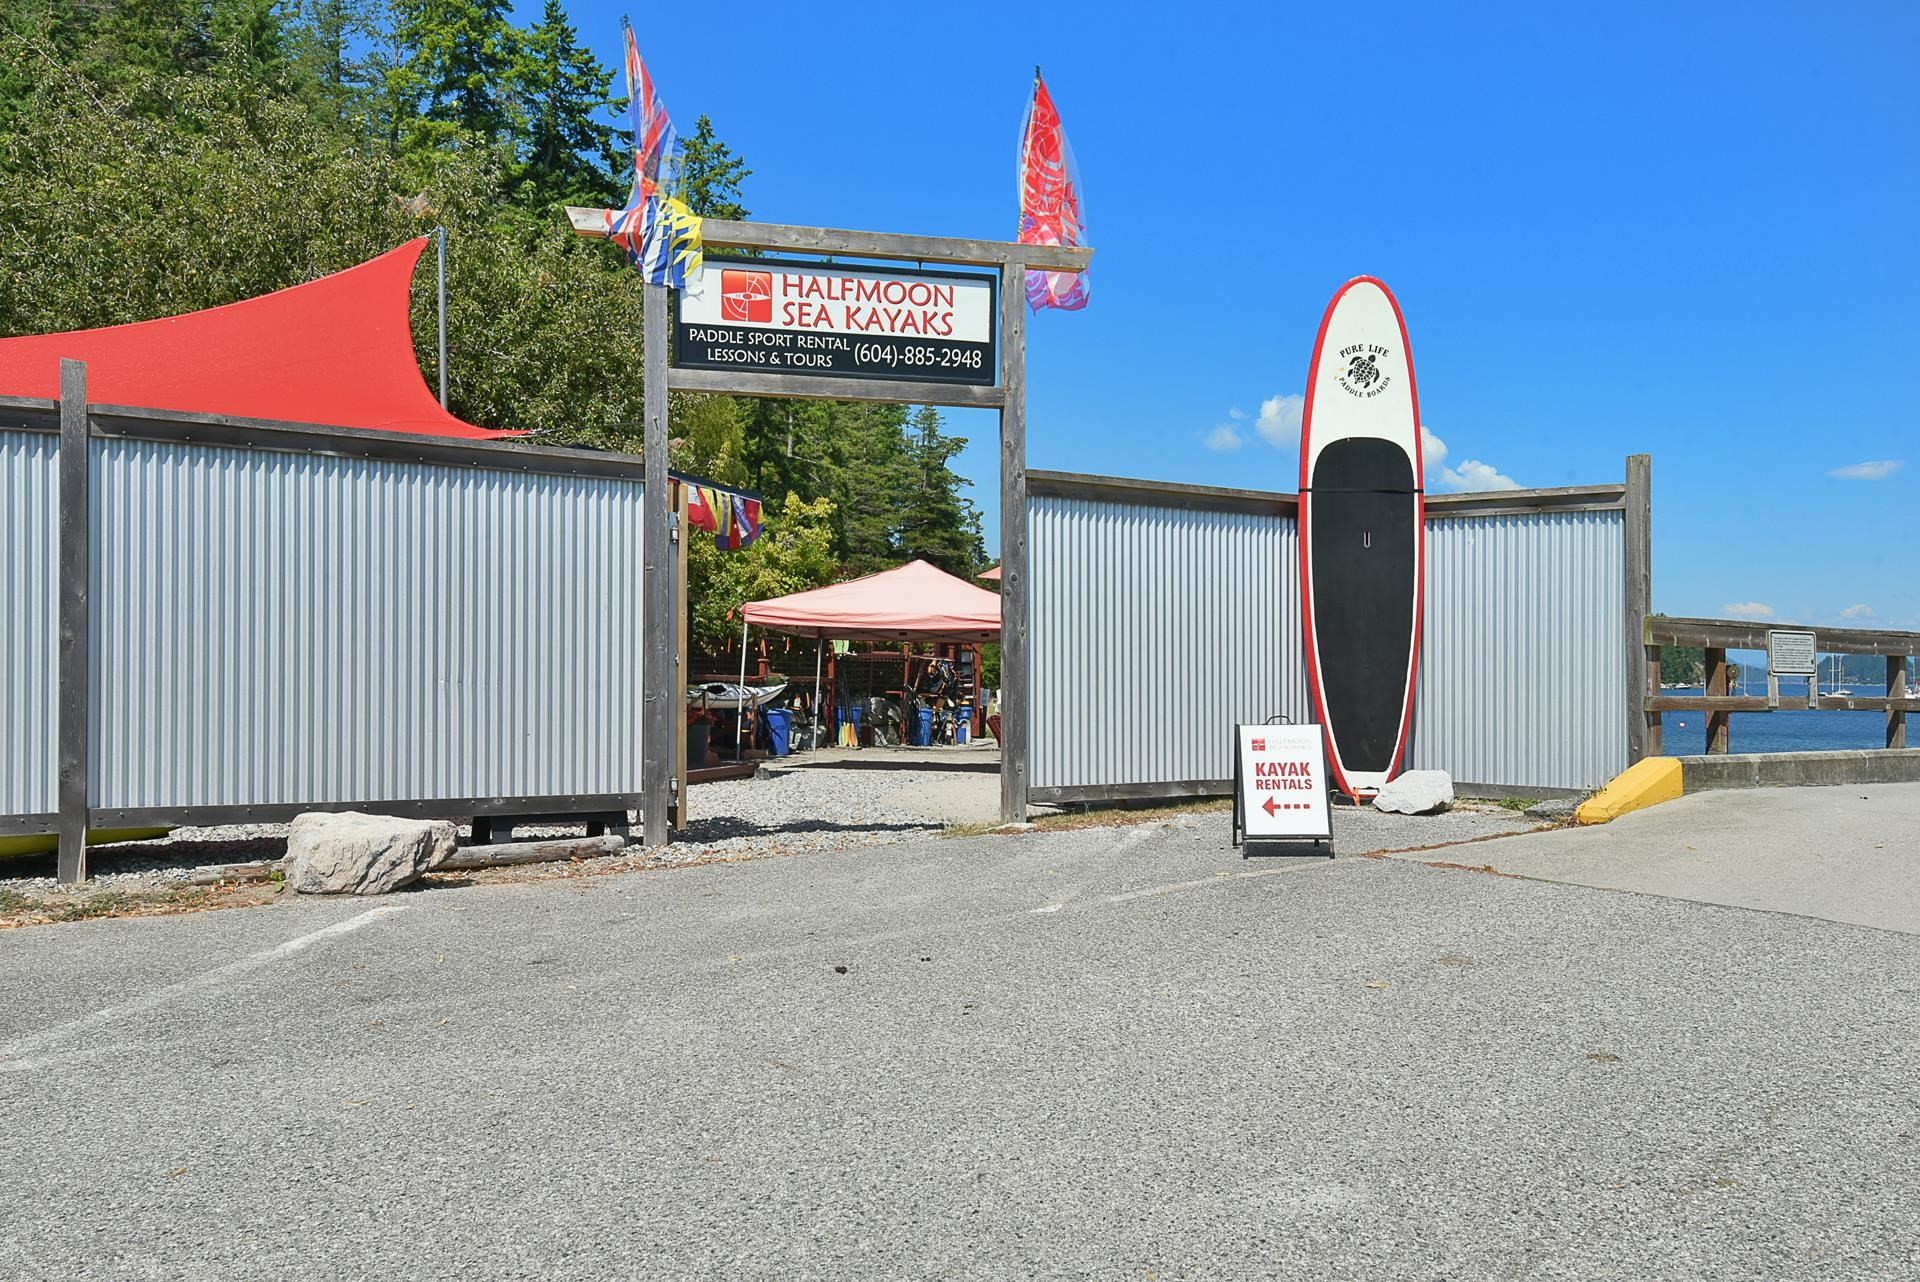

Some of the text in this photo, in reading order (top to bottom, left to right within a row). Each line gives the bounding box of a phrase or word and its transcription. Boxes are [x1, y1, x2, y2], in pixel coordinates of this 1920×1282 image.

[782, 273, 954, 308] HALFMOON
[782, 301, 953, 336] SEA KAYAKS
[689, 328, 850, 350] PADDLE SPORT RENTAL
[707, 348, 833, 367] LESSONS & TOURS
[854, 342, 982, 368] (604)-885-2948
[1339, 344, 1390, 358] PURE LIFE
[1339, 376, 1391, 398] PADDLE BOARDS
[1255, 762, 1311, 777] KAYAK
[1256, 779, 1313, 790] RENTALS
